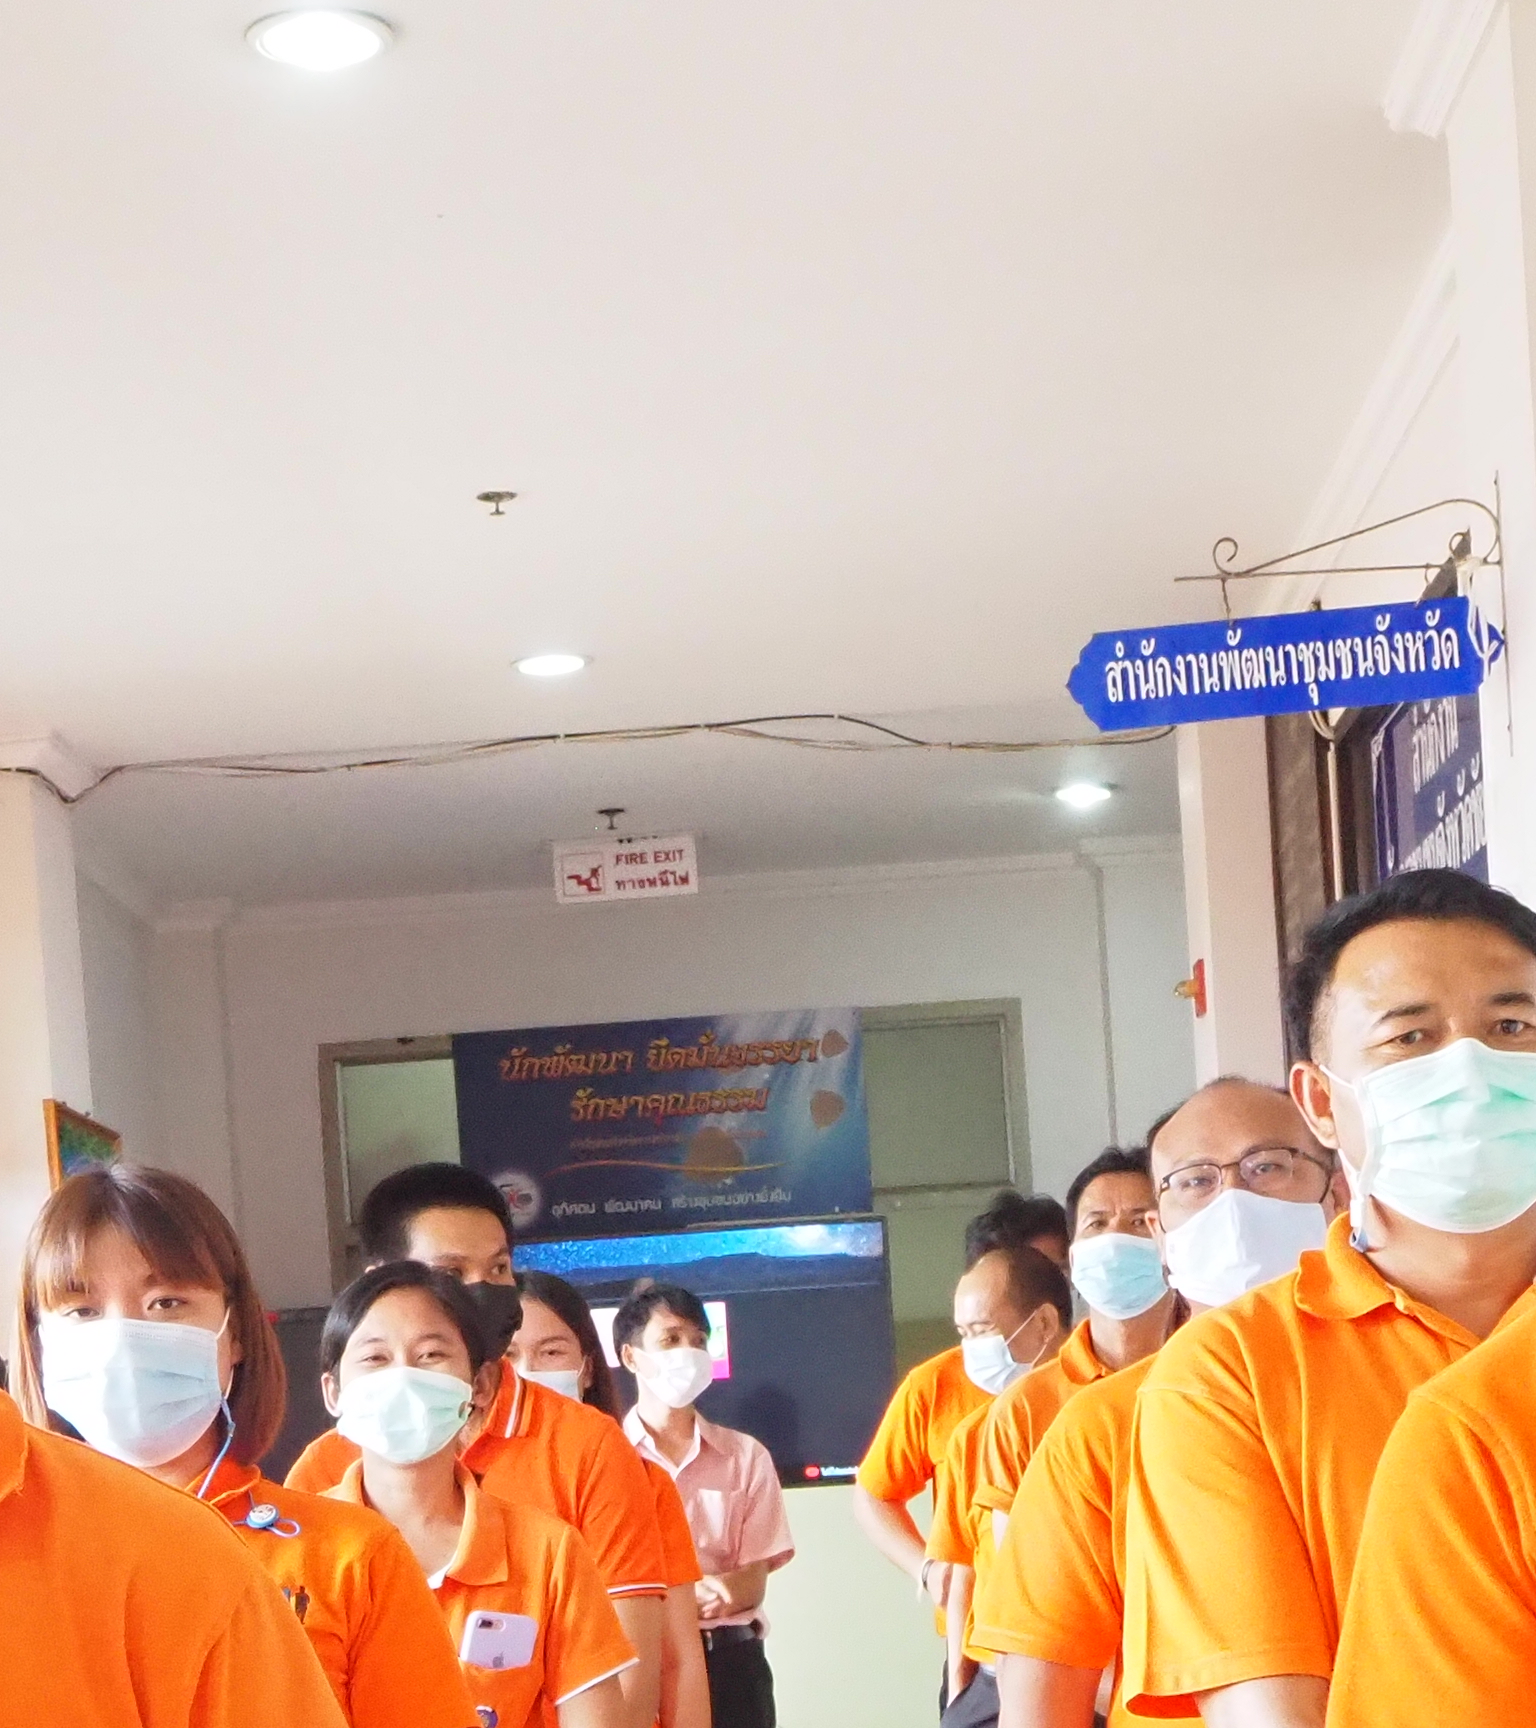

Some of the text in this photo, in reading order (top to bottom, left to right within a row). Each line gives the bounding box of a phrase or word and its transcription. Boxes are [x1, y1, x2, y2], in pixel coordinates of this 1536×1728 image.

[1104, 608, 1460, 706] สำนักงานพัฒนาชุมชนจังหวัด
[615, 849, 684, 866] FIRE EXIT
[615, 869, 690, 891] ทางหนีไฟ
